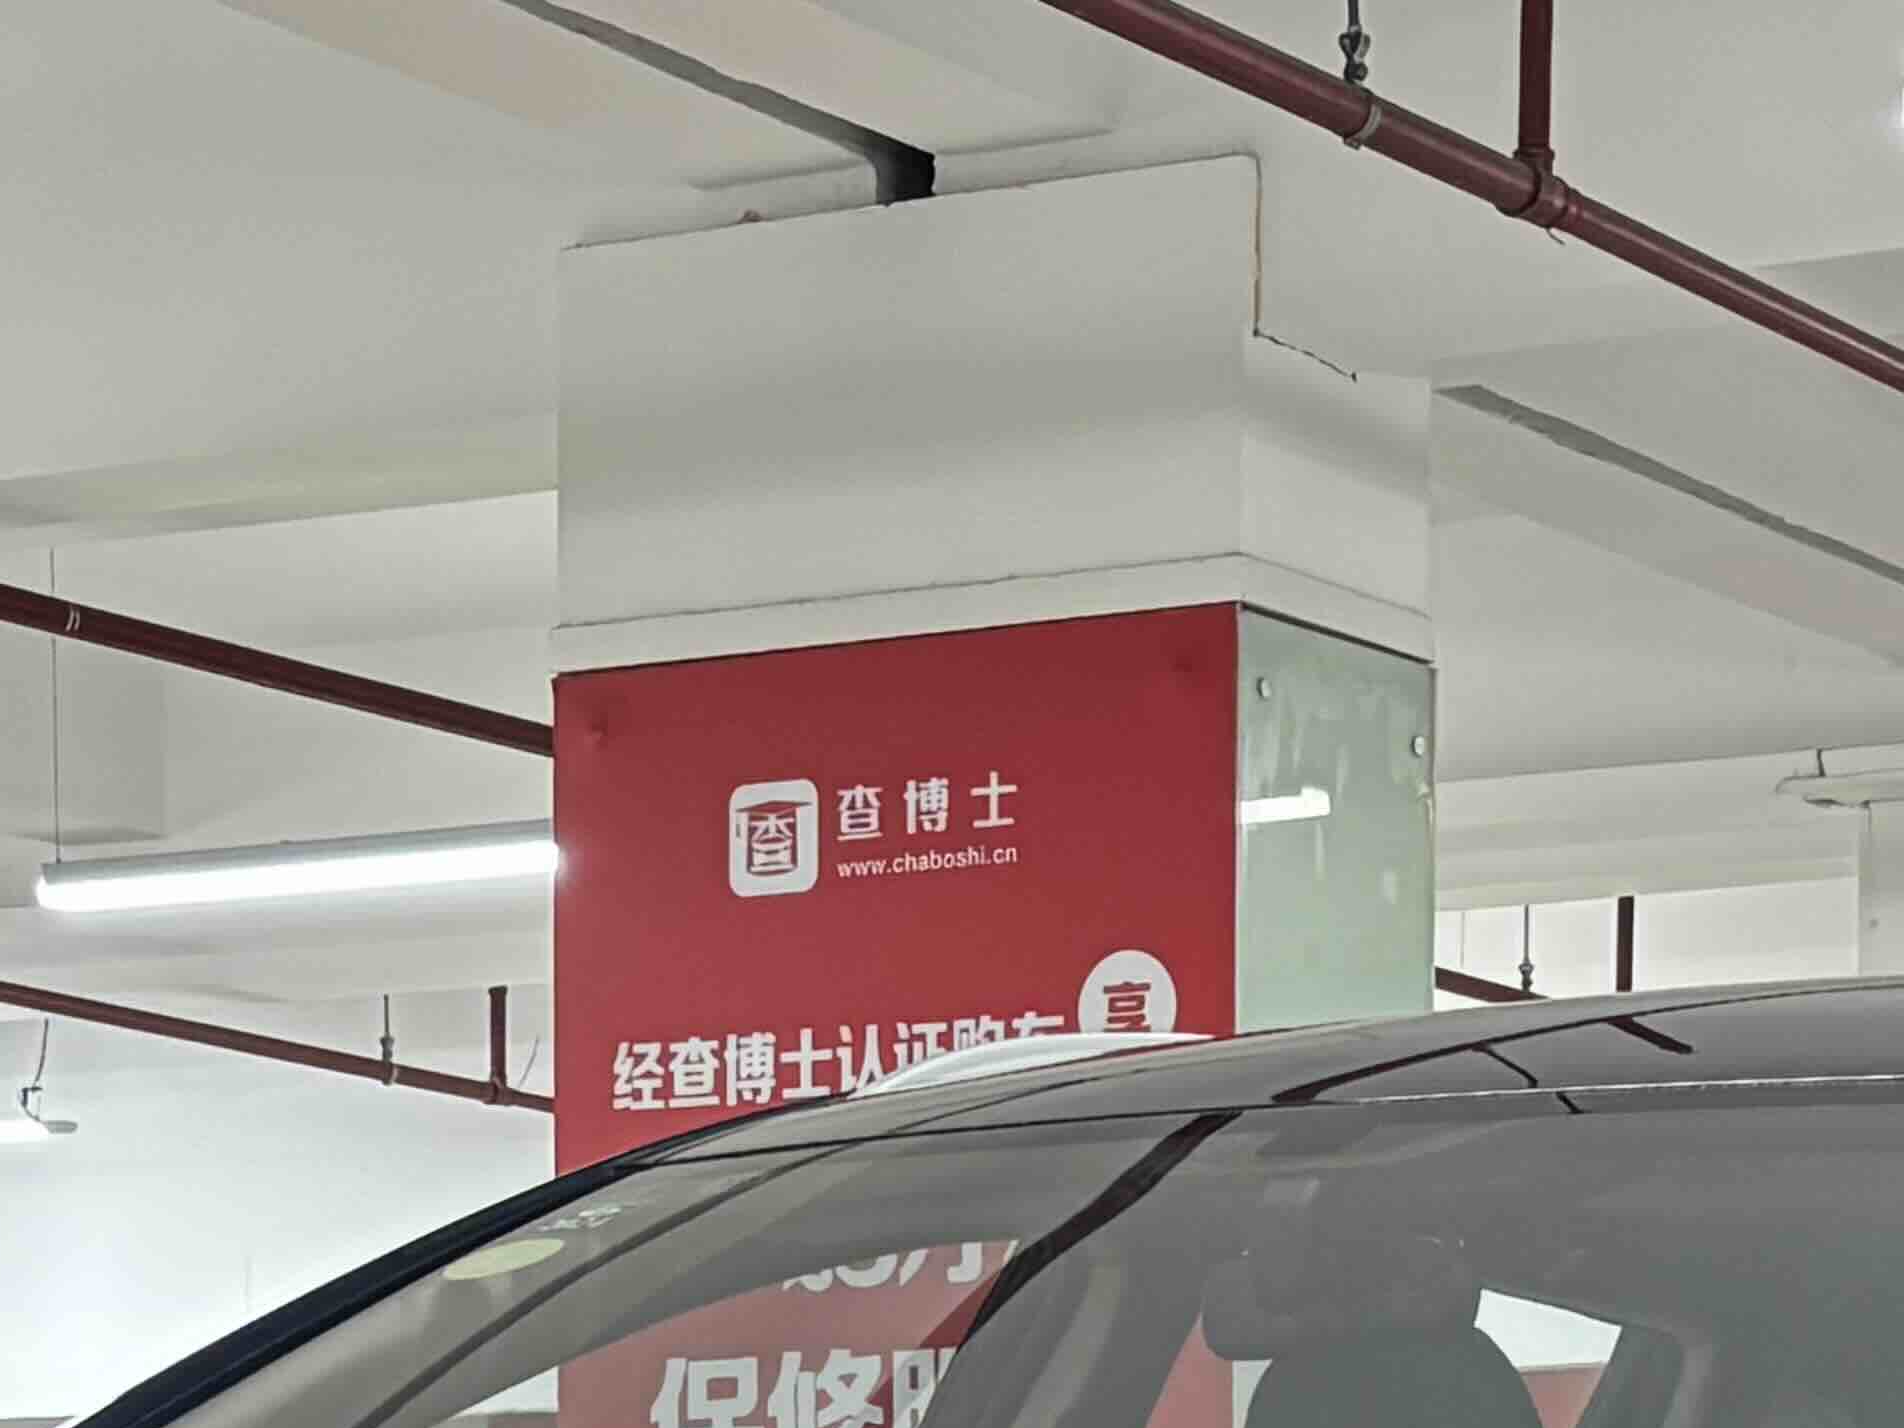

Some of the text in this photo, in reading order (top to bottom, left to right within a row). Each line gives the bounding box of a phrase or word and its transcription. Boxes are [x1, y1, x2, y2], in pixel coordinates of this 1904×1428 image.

[836, 770, 1019, 842] 查博士
[836, 844, 1019, 878] www.chaboshi.cn
